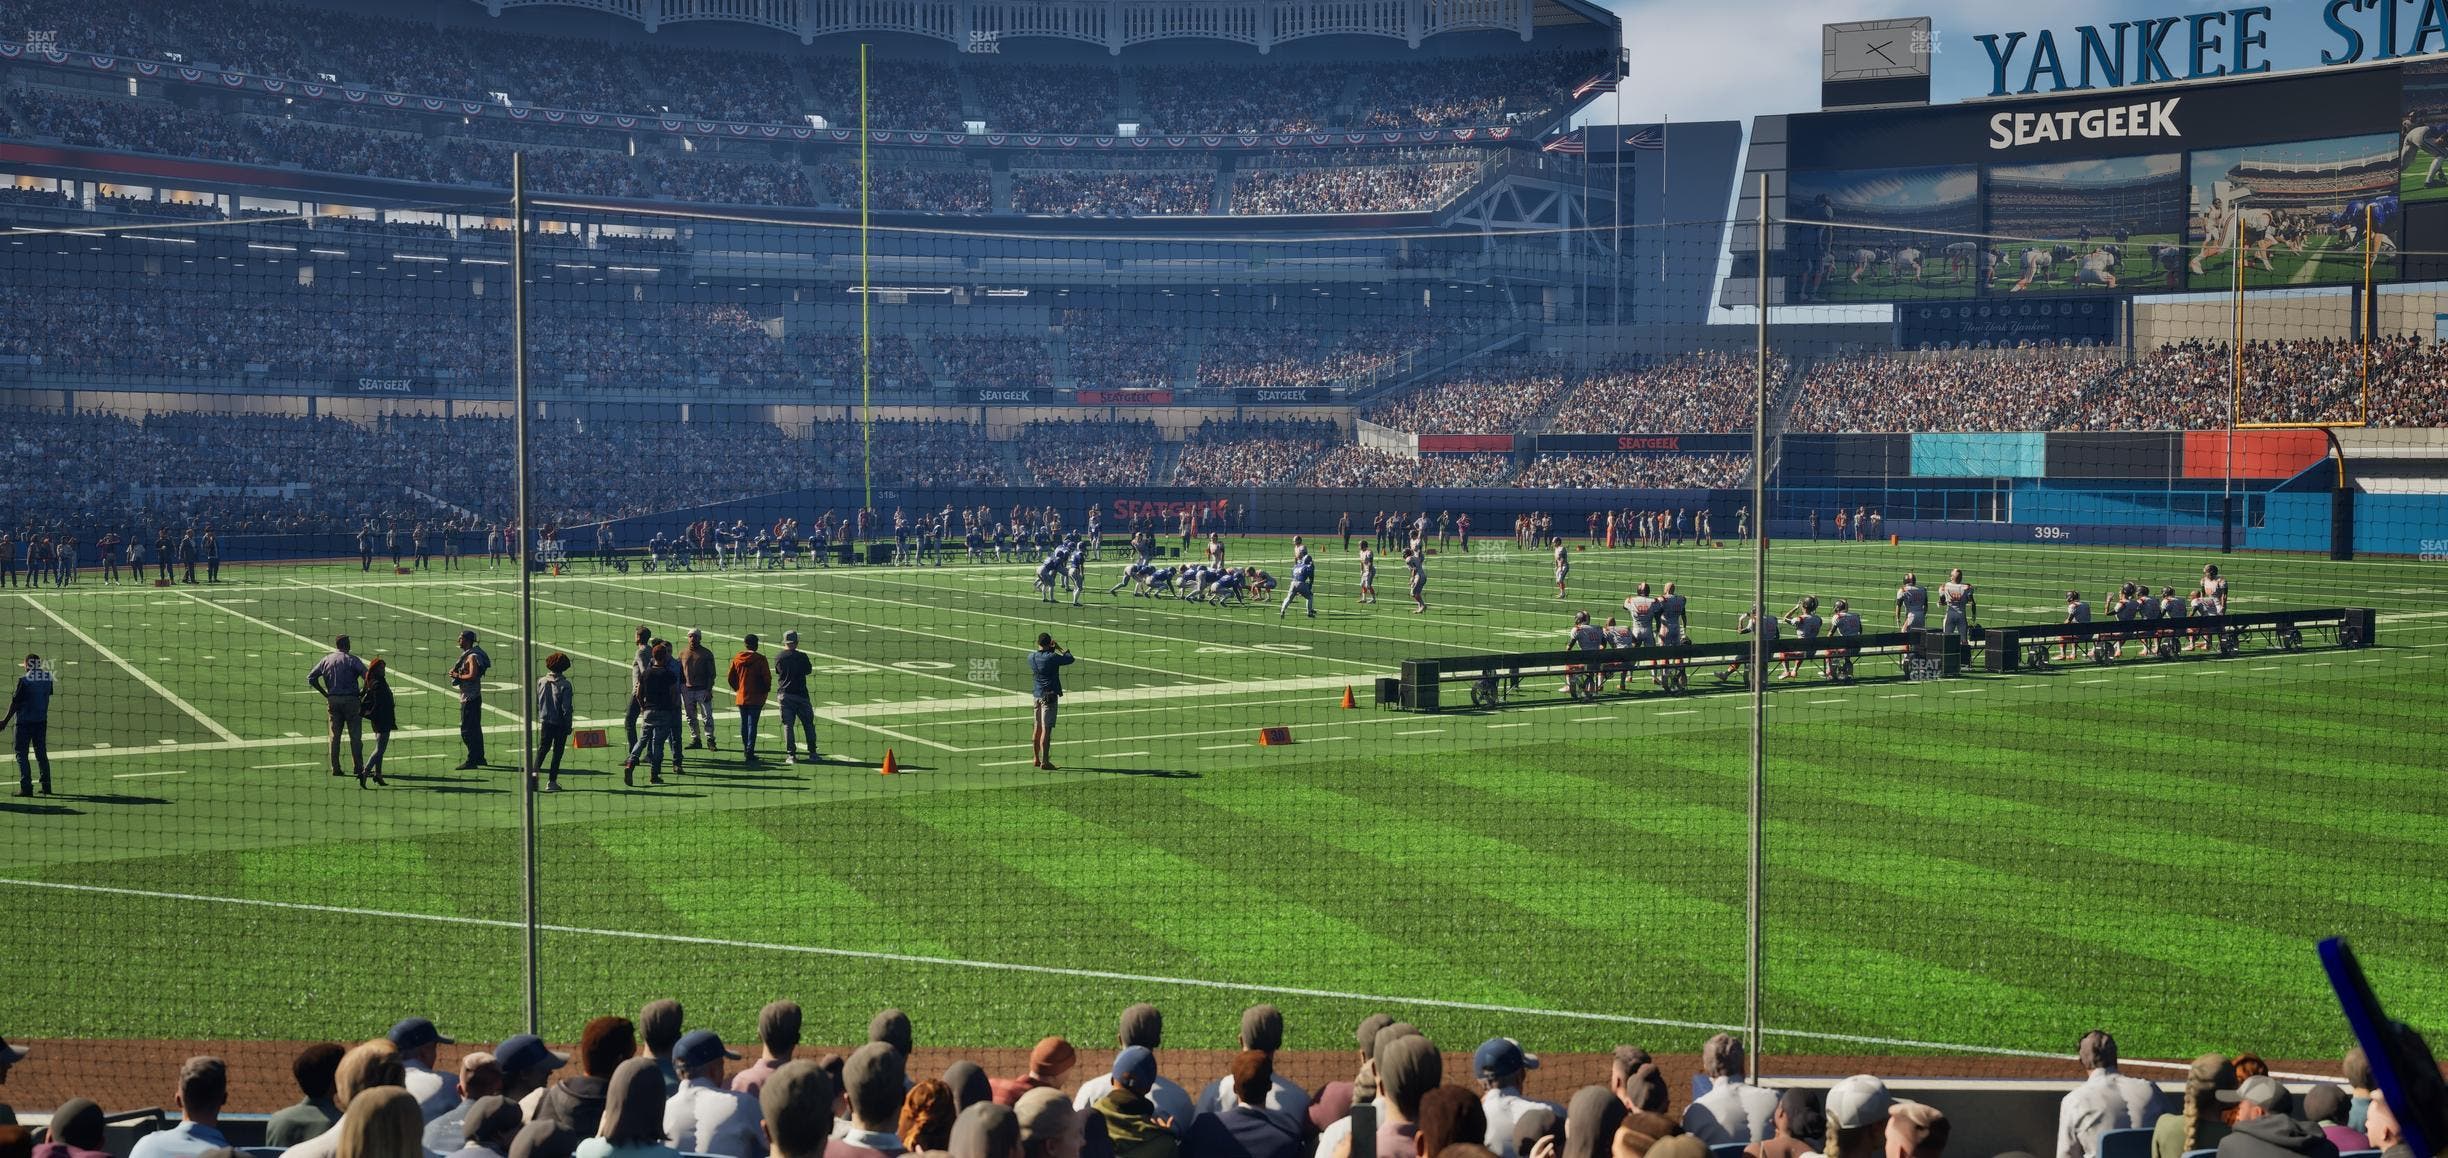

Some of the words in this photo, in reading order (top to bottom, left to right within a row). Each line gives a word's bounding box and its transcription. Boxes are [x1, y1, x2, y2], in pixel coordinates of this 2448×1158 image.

[1973, 5, 2272, 97] YANKEE
[2320, 0, 2448, 66] STA
[1989, 97, 2182, 151] SEATGEEK
[358, 378, 412, 392] SEATGEEK
[979, 389, 1030, 401] SEATGEEK
[1256, 390, 1307, 402] SEATGEEK
[1617, 436, 1680, 450] SEATGEEK
